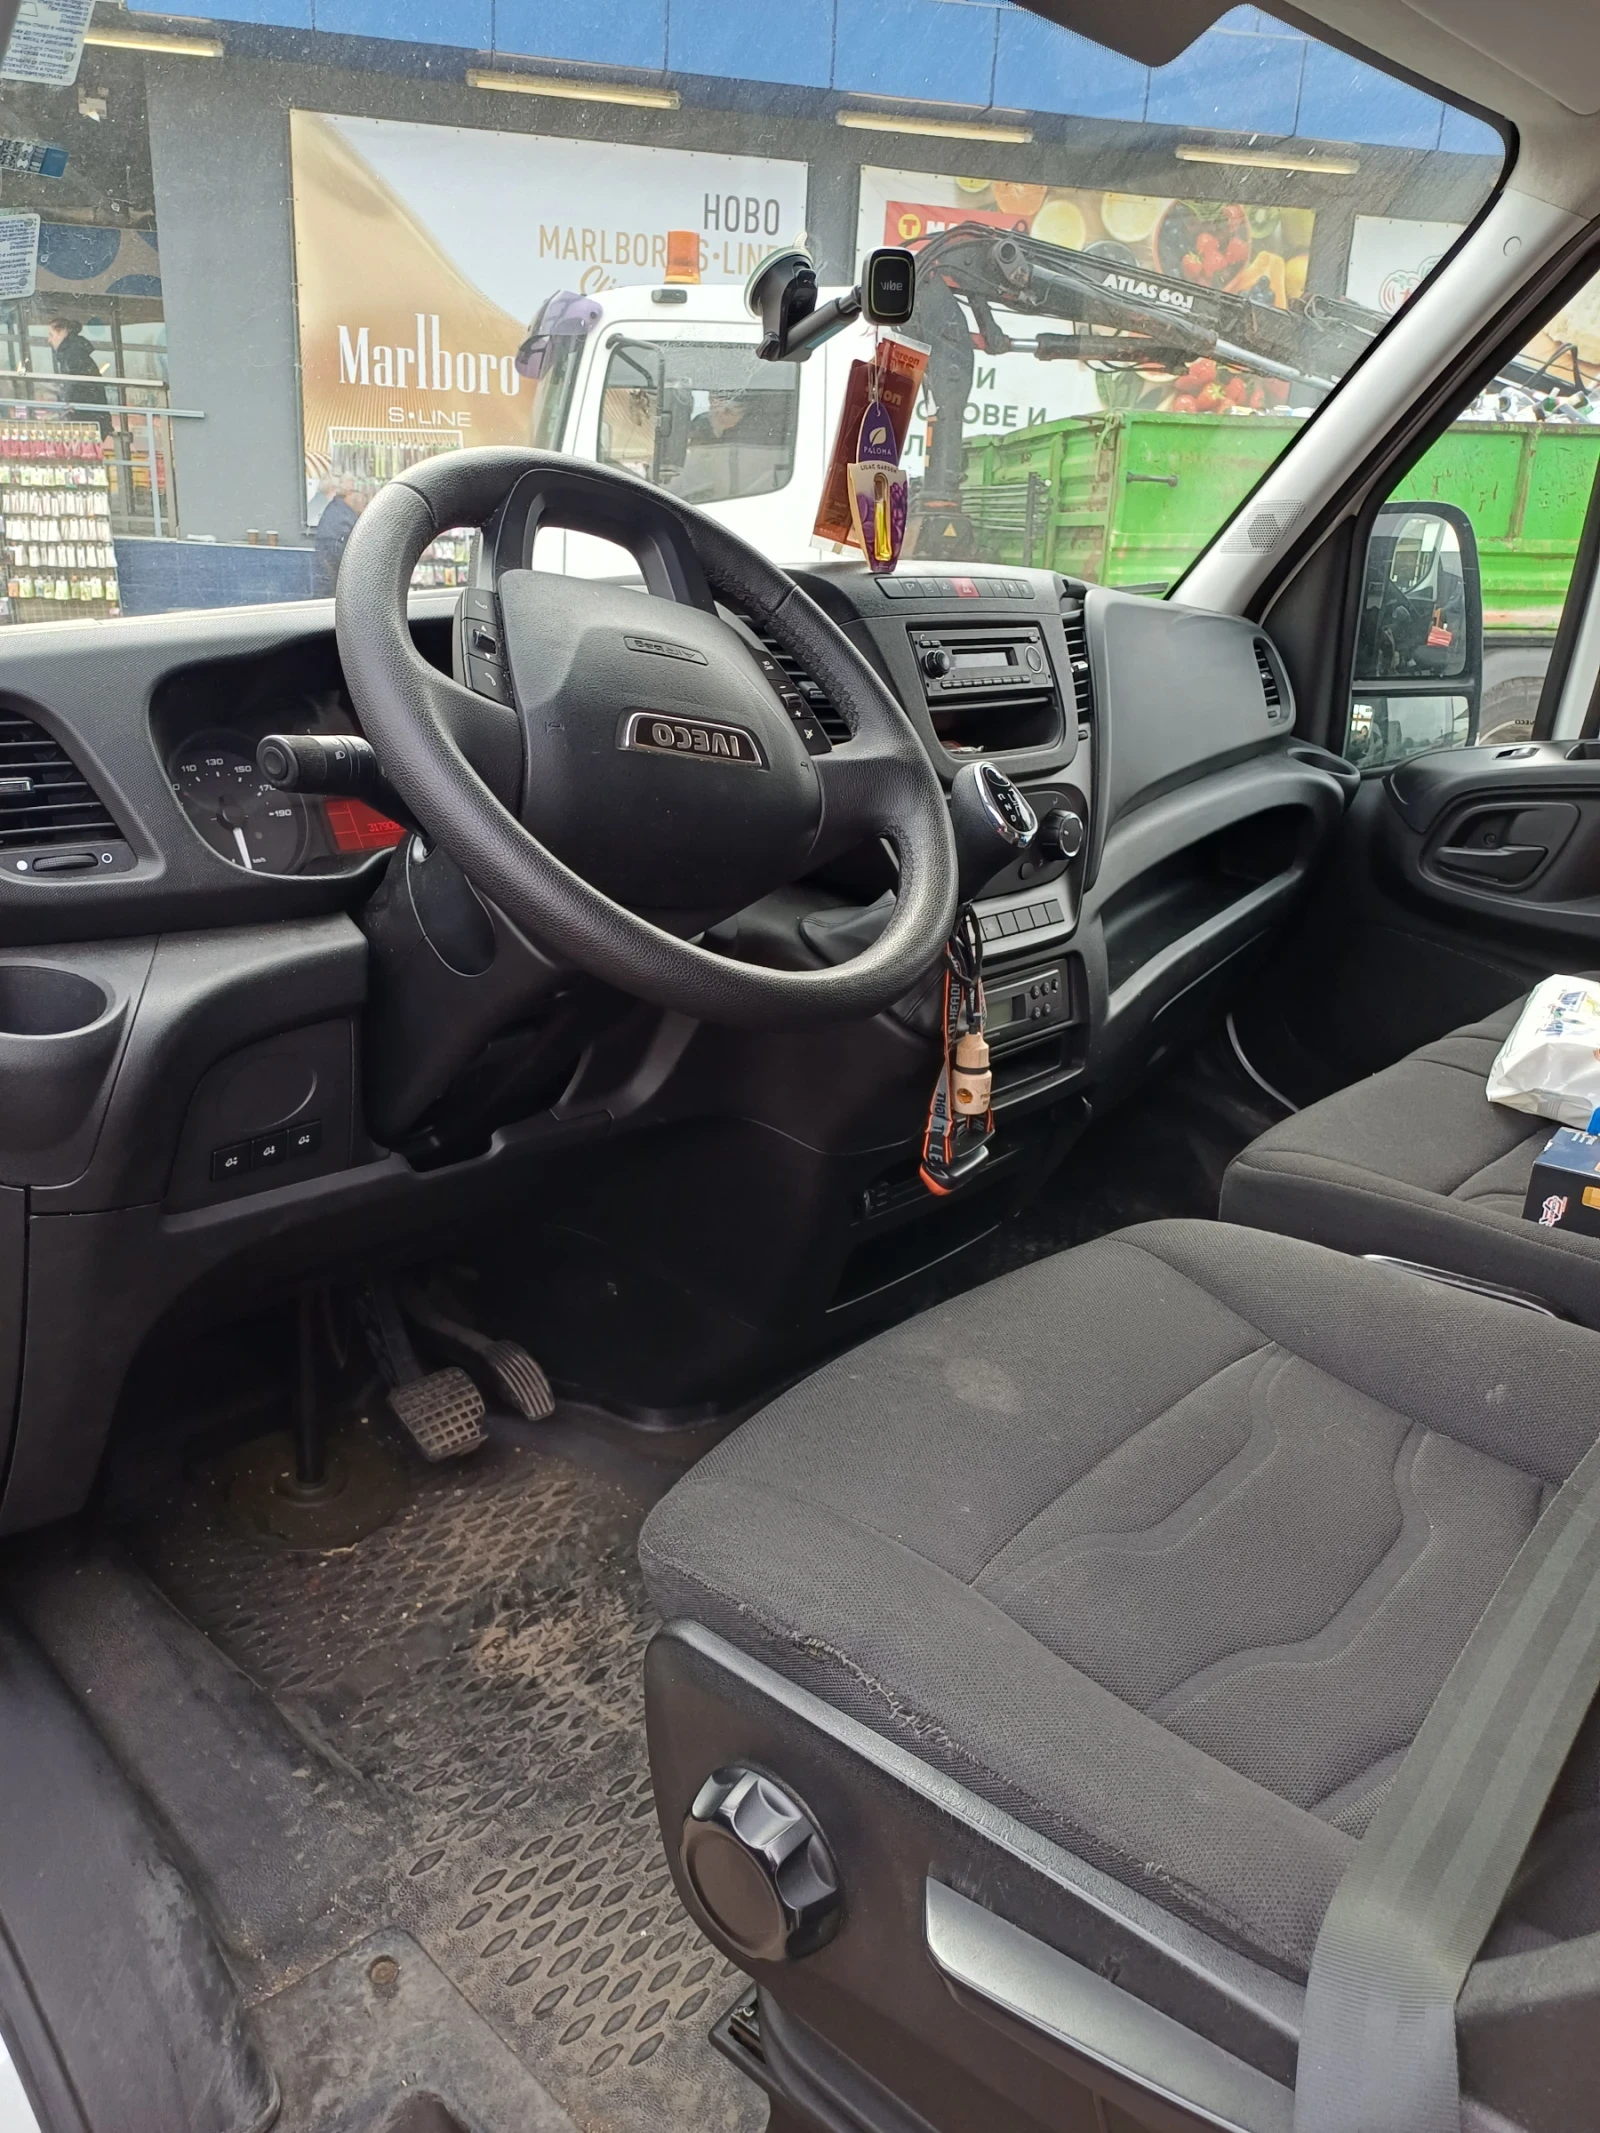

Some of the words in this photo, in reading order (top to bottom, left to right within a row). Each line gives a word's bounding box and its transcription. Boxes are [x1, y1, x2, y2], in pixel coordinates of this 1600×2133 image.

[539, 224, 667, 268] MARLBOR
[880, 280, 903, 291] vibe
[1101, 273, 1159, 299] ATLAS
[337, 313, 520, 396] Marlboro
[863, 445, 892, 456] PALOMA
[860, 463, 876, 471] LILAC
[876, 463, 898, 475] GARDEN
[651, 722, 740, 758] IVECO
[205, 758, 224, 766] 130
[181, 764, 197, 772] 110
[233, 765, 252, 773] 150
[274, 809, 292, 817] 190
